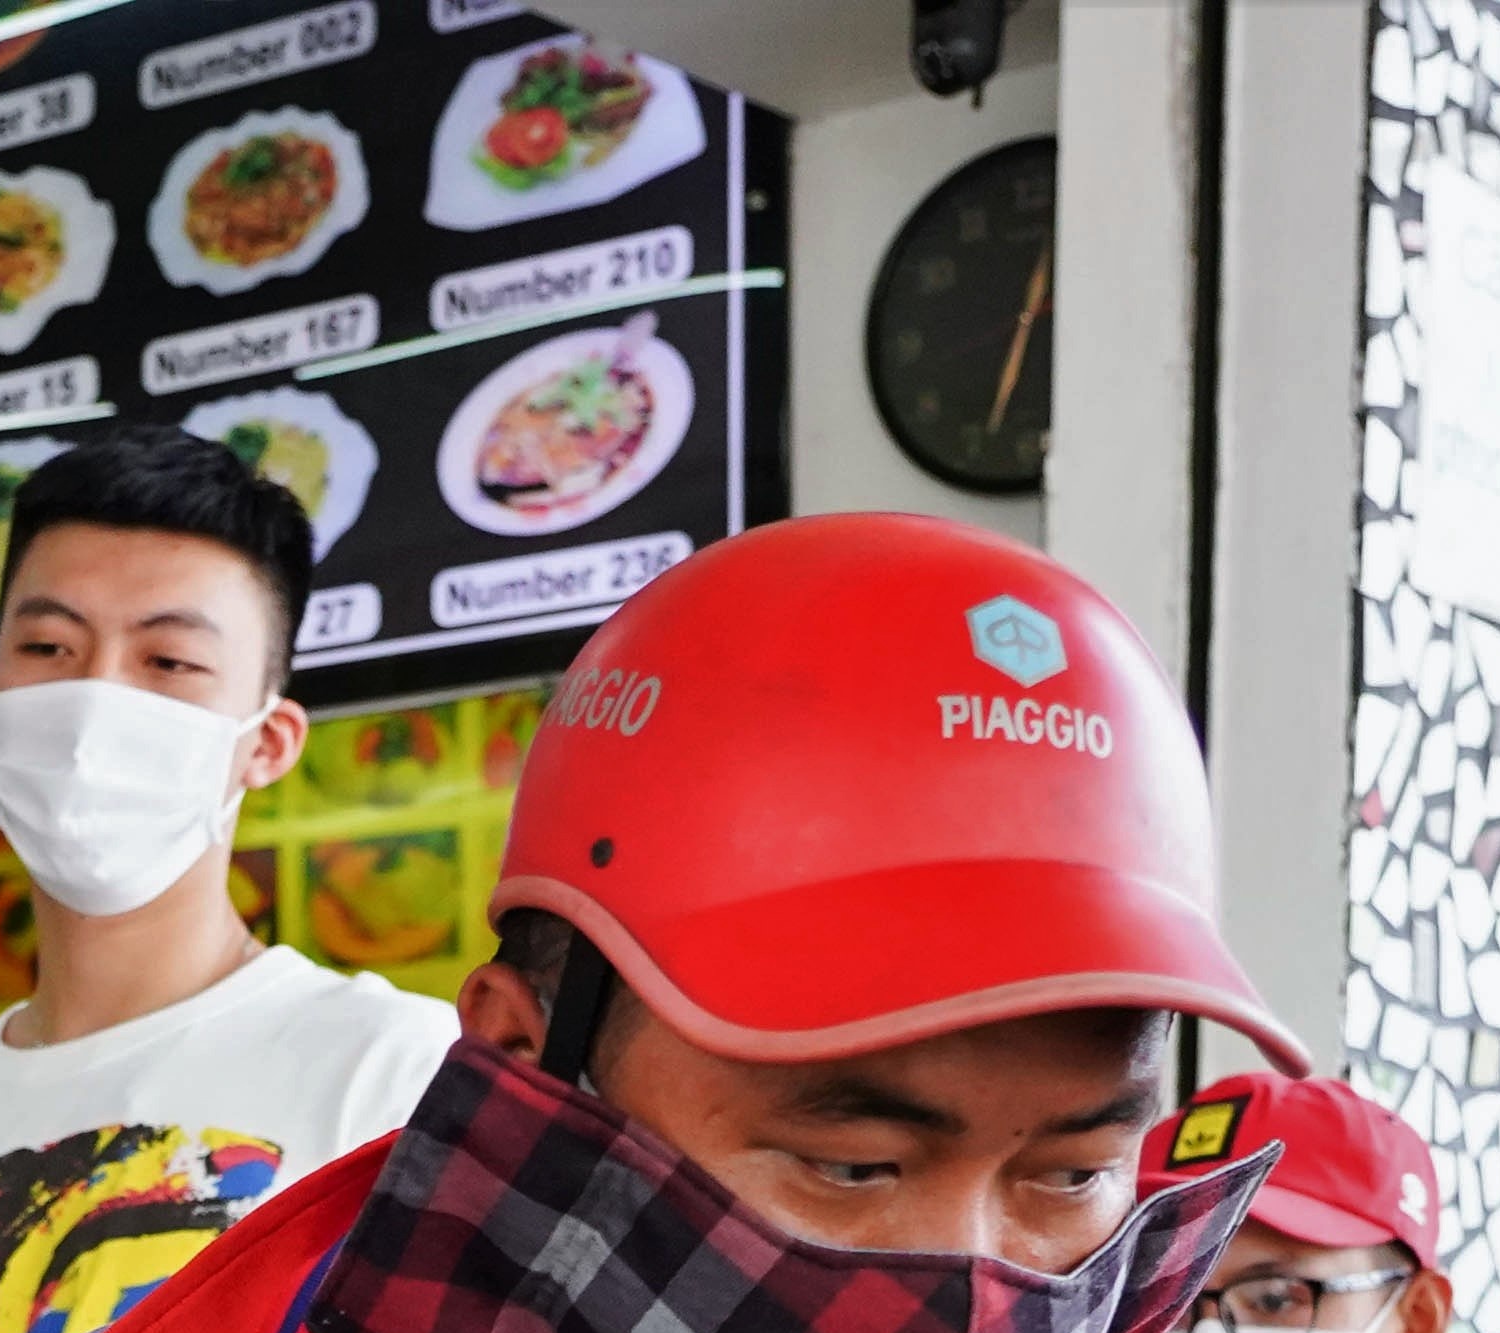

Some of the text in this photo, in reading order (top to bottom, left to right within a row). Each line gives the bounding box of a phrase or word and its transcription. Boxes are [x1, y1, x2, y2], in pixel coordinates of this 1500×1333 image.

[152, 9, 362, 91] Number 002
[444, 238, 676, 317] Number 210
[154, 305, 363, 379] Number 167
[314, 595, 355, 638] 27
[445, 565, 596, 612] Number
[548, 668, 661, 737] AGGIO
[937, 694, 1113, 759] PIAGGIO
